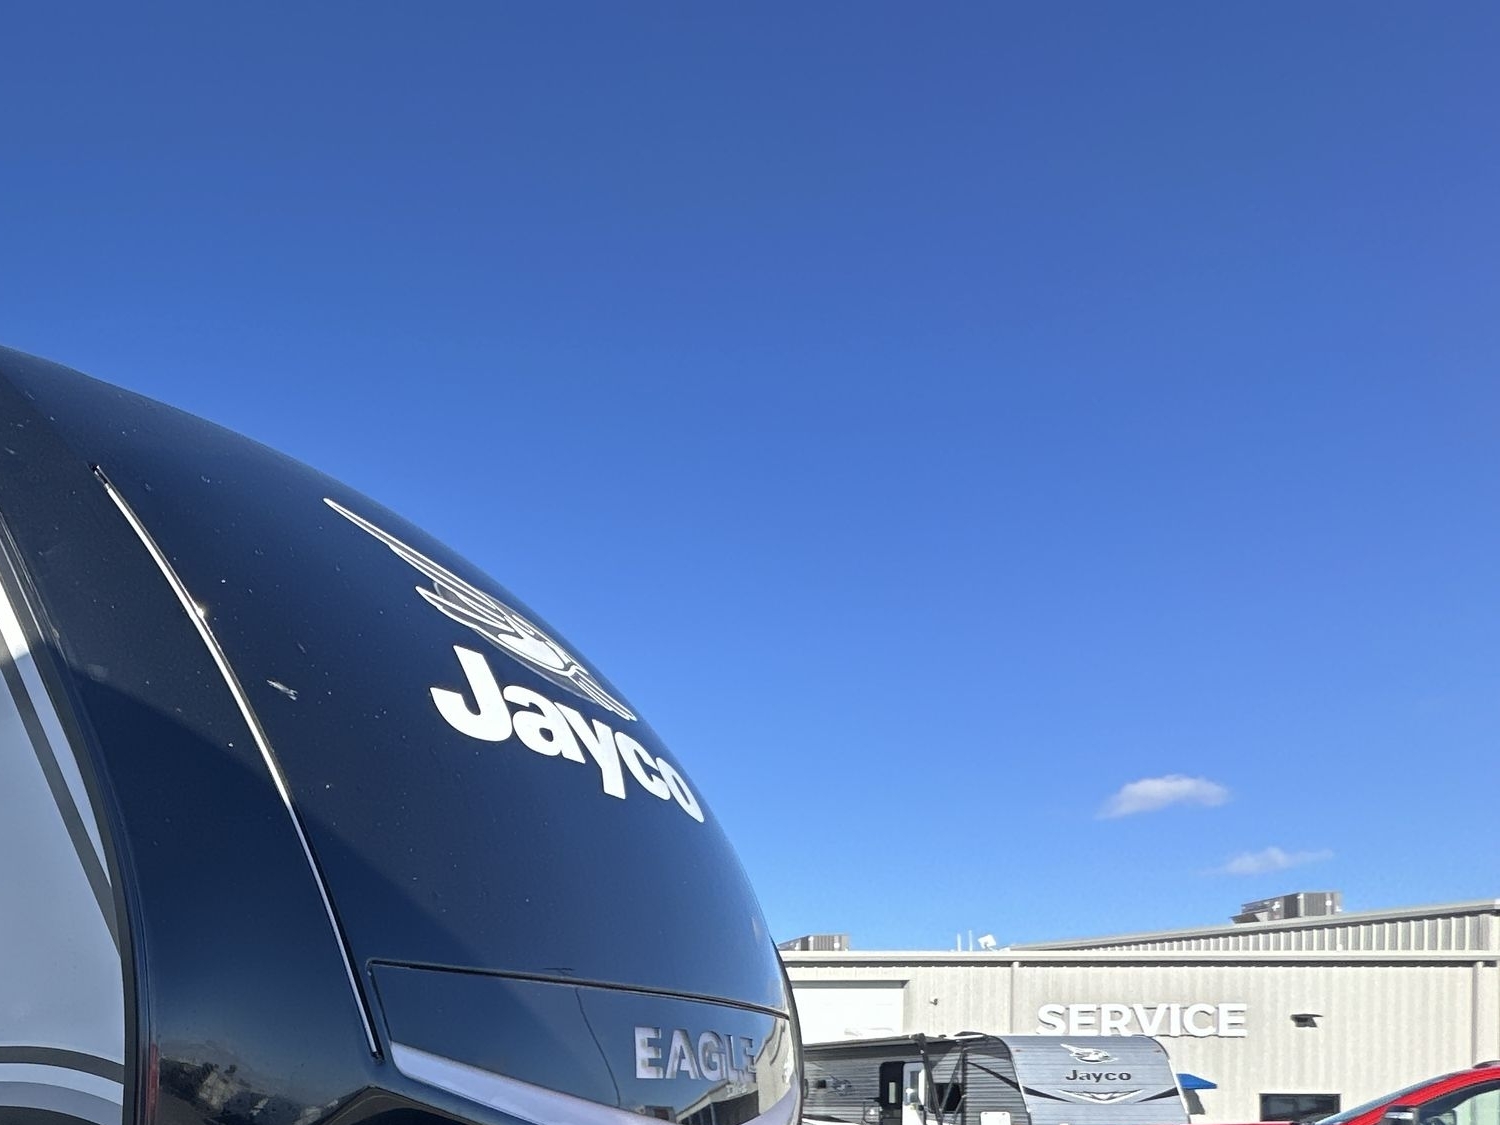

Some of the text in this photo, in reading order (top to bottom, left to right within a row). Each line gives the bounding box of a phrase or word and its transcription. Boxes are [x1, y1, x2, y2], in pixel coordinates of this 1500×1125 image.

[430, 645, 704, 823] Jayco
[1036, 1002, 1247, 1037] SERVICE
[635, 1026, 757, 1083] EAGLE
[1065, 1069, 1132, 1084] Jayco
